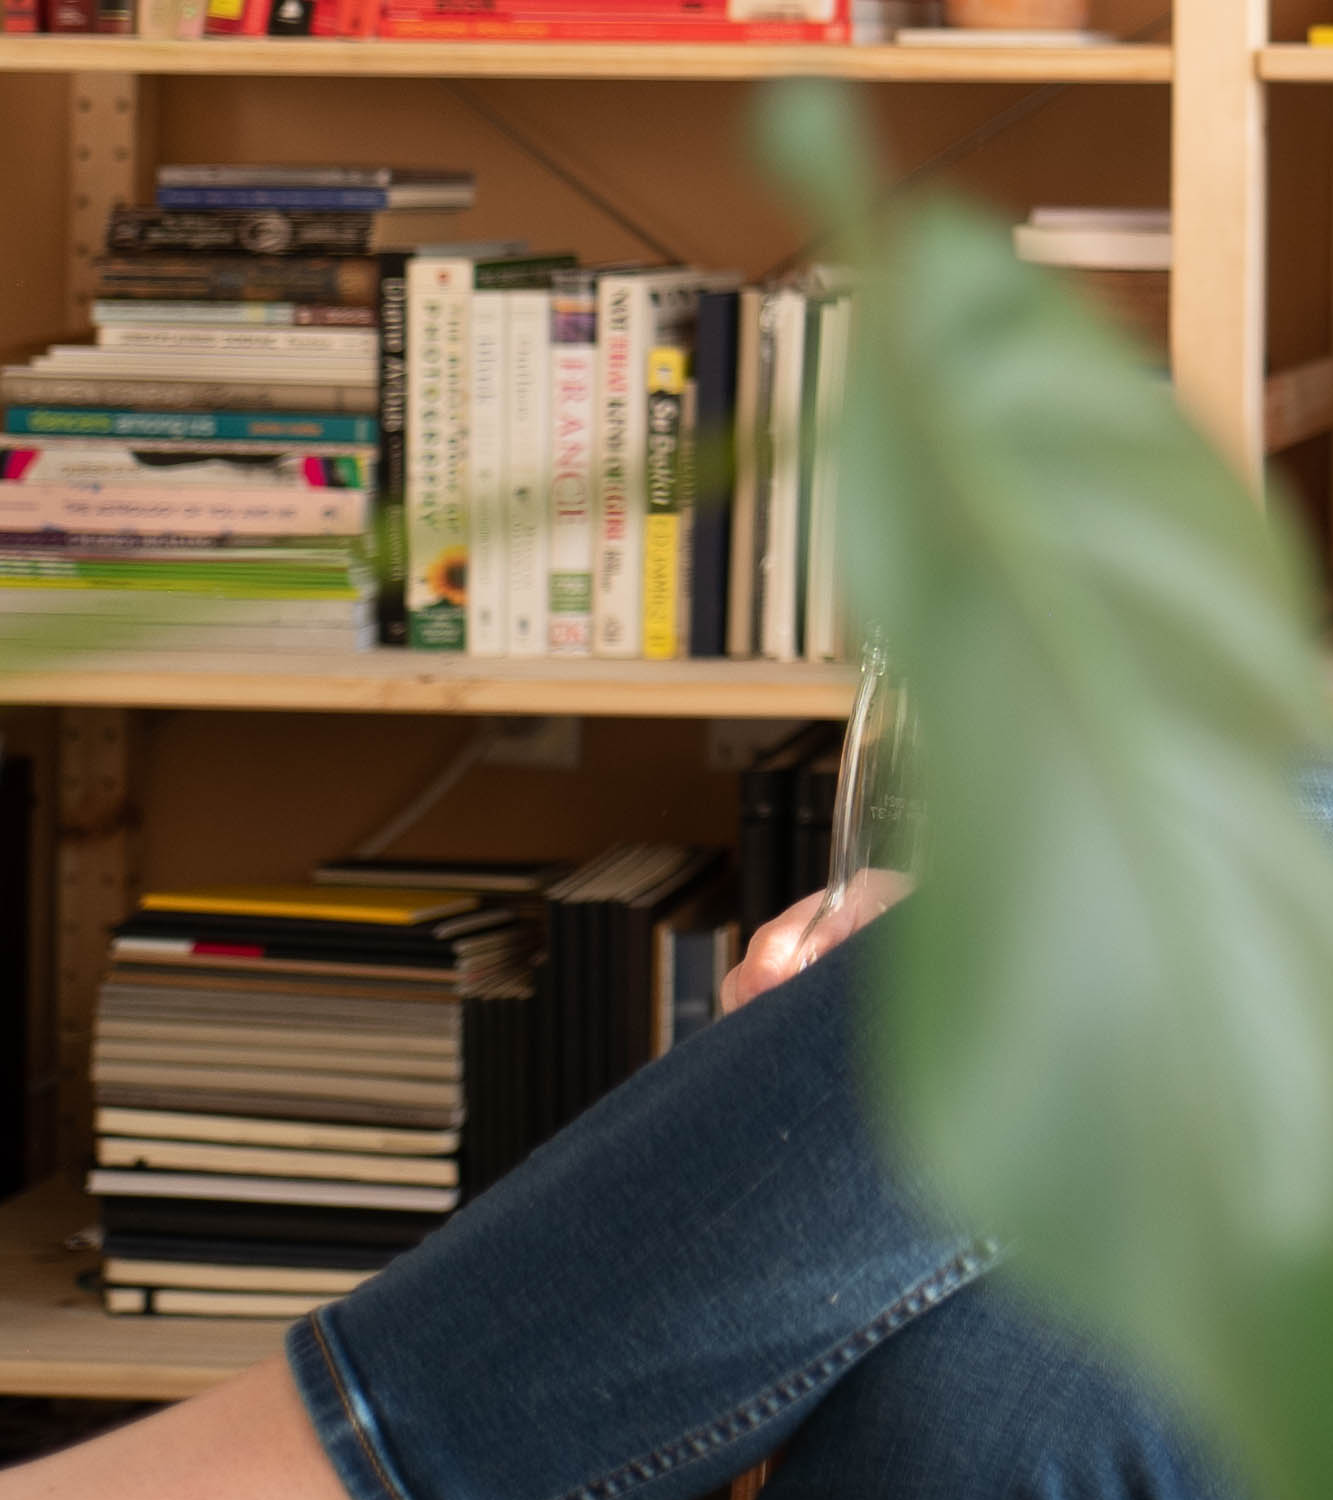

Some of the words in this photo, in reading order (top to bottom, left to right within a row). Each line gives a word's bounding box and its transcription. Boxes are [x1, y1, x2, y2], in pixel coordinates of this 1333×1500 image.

[609, 290, 629, 332] NOT
[382, 355, 406, 433] Arbus
[608, 336, 629, 393] THAT
[421, 303, 443, 530] PHOTOGRAPHY
[554, 357, 586, 525] FRANCE
